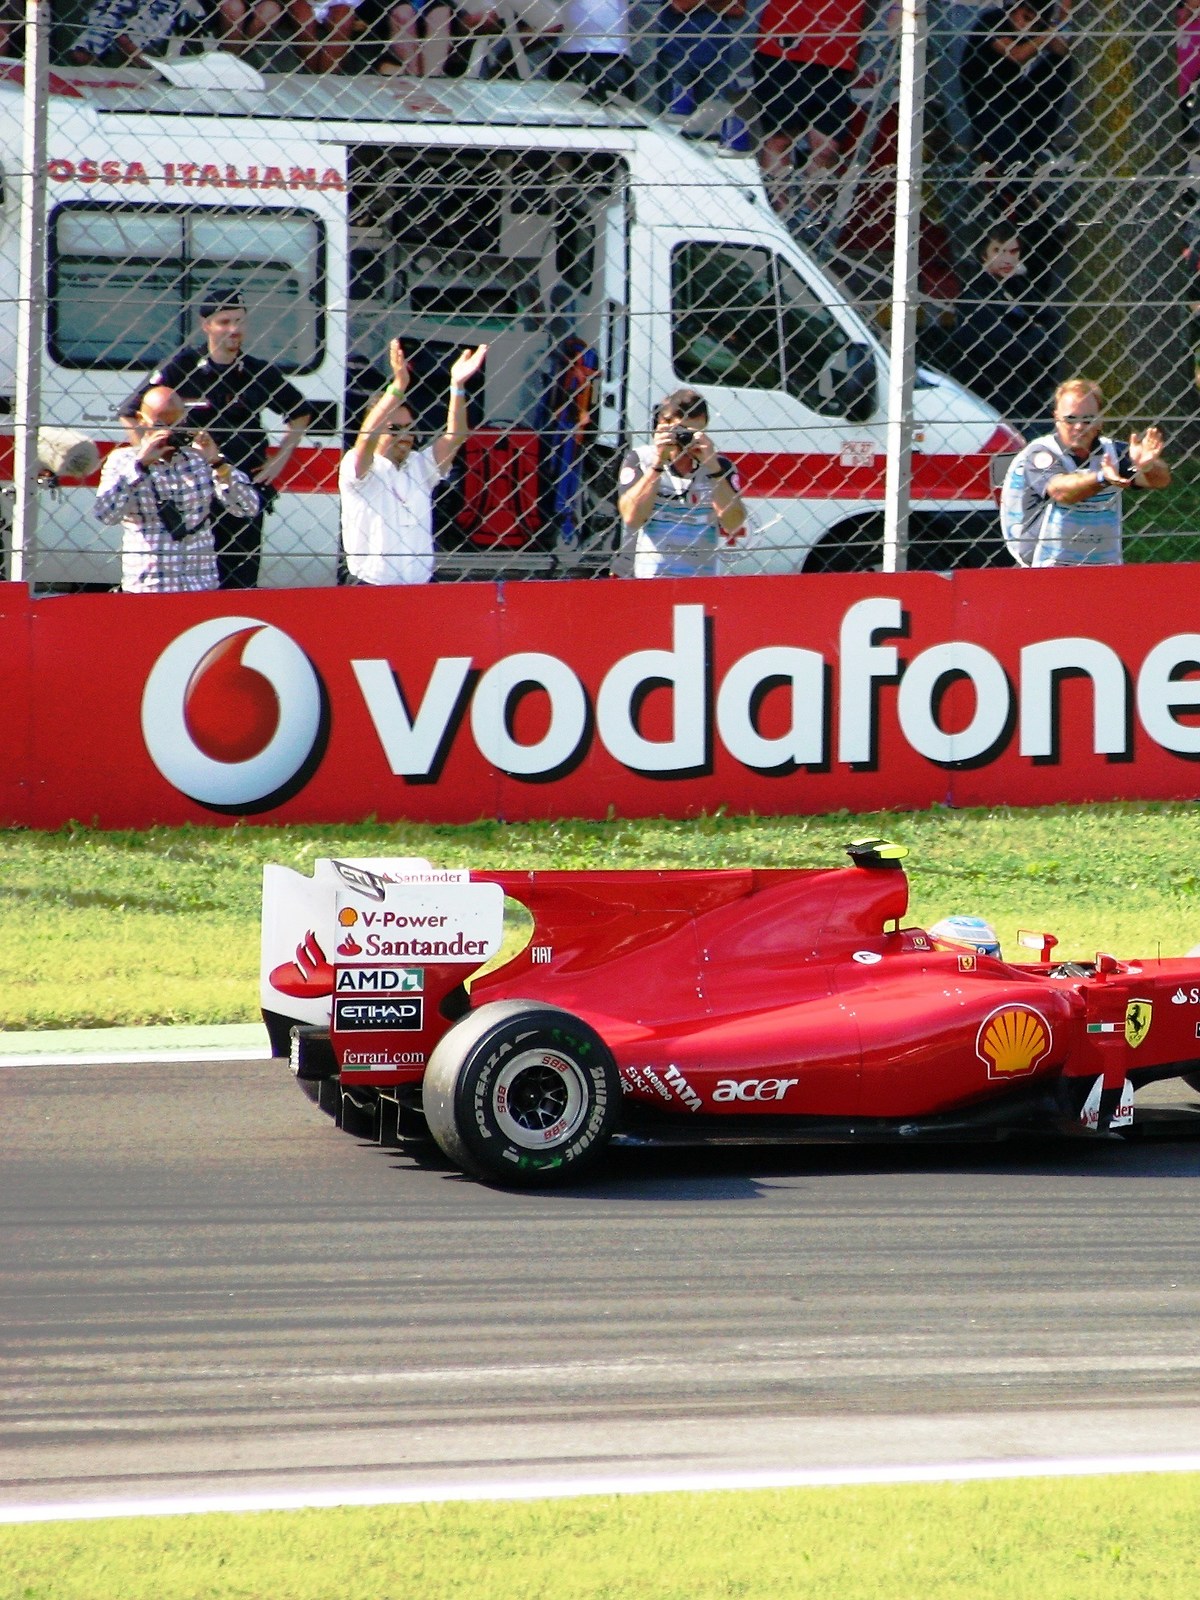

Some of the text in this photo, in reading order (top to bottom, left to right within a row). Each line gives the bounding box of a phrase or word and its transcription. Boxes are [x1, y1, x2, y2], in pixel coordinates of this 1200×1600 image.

[48, 158, 348, 192] OSSA ITALIANA
[395, 872, 462, 884] Santander
[361, 911, 448, 928] V-Power
[366, 931, 489, 957] Santander
[531, 946, 553, 964] FIAT
[337, 970, 400, 990] AMD
[340, 1004, 417, 1018] ETIHAD
[342, 1048, 425, 1064] ferrari.com
[474, 1042, 513, 1139] POTENZA
[625, 1066, 654, 1095] SKF
[642, 1065, 673, 1101] brembo
[664, 1063, 704, 1112] TATA
[712, 1078, 799, 1102] acer
[564, 1066, 607, 1162] BRIDGESTONE
